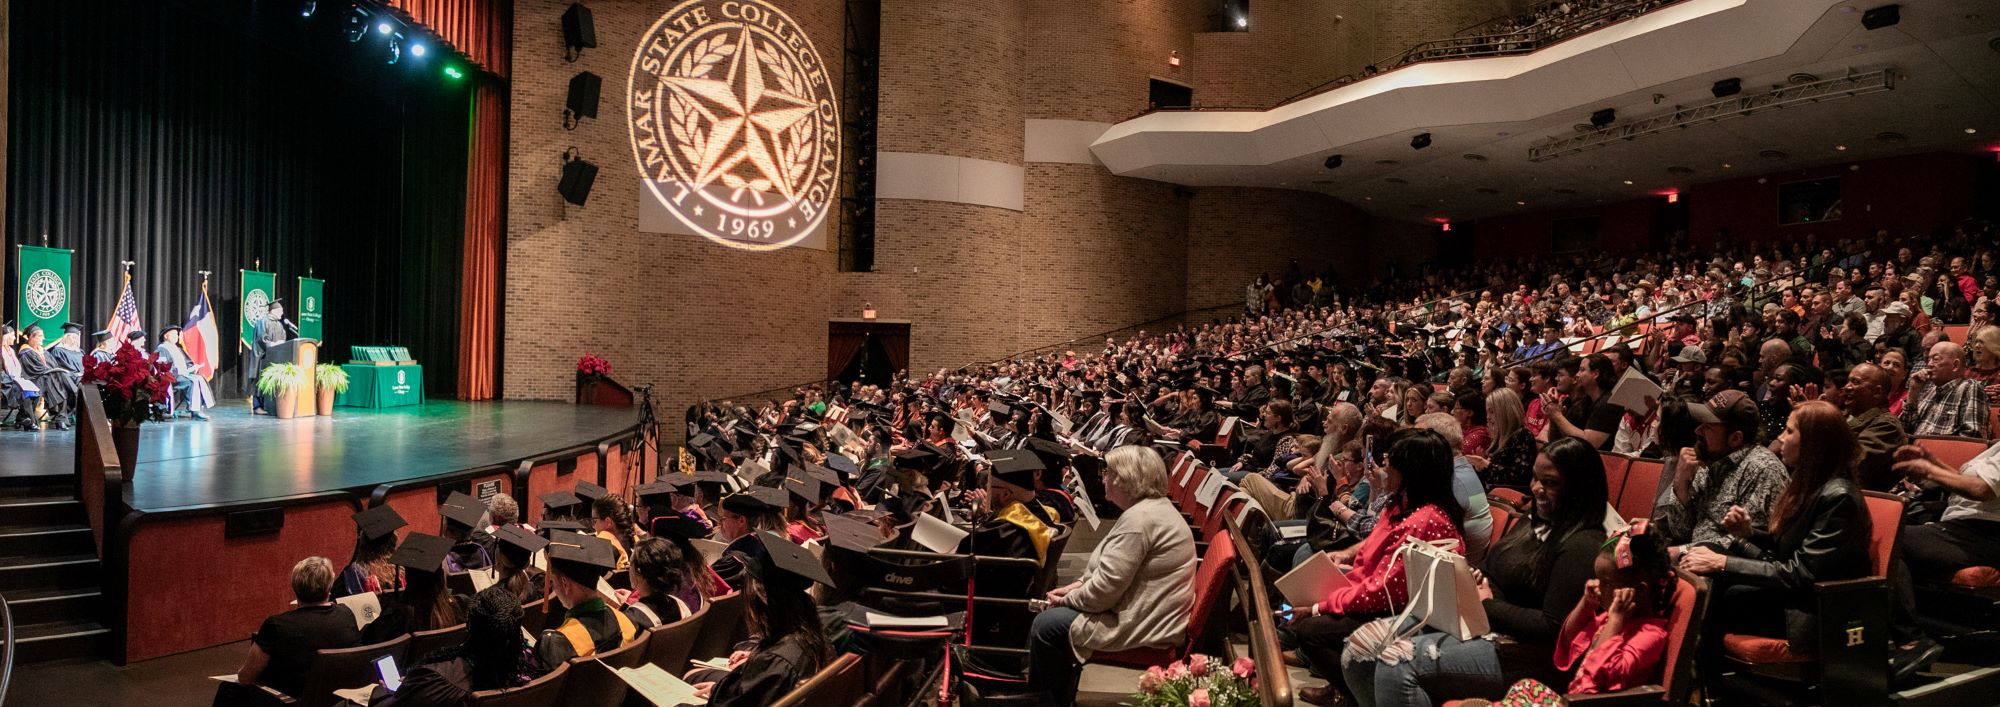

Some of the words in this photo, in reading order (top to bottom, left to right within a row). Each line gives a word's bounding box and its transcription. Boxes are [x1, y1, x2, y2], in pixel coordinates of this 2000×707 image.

[641, 5, 711, 75] STATE
[721, 1, 825, 88] COLLEGE
[635, 89, 690, 206] LAMAR
[798, 98, 836, 222] ORANGE
[717, 214, 775, 238] 1969
[884, 573, 914, 585] drive
[1846, 626, 1865, 647] H
